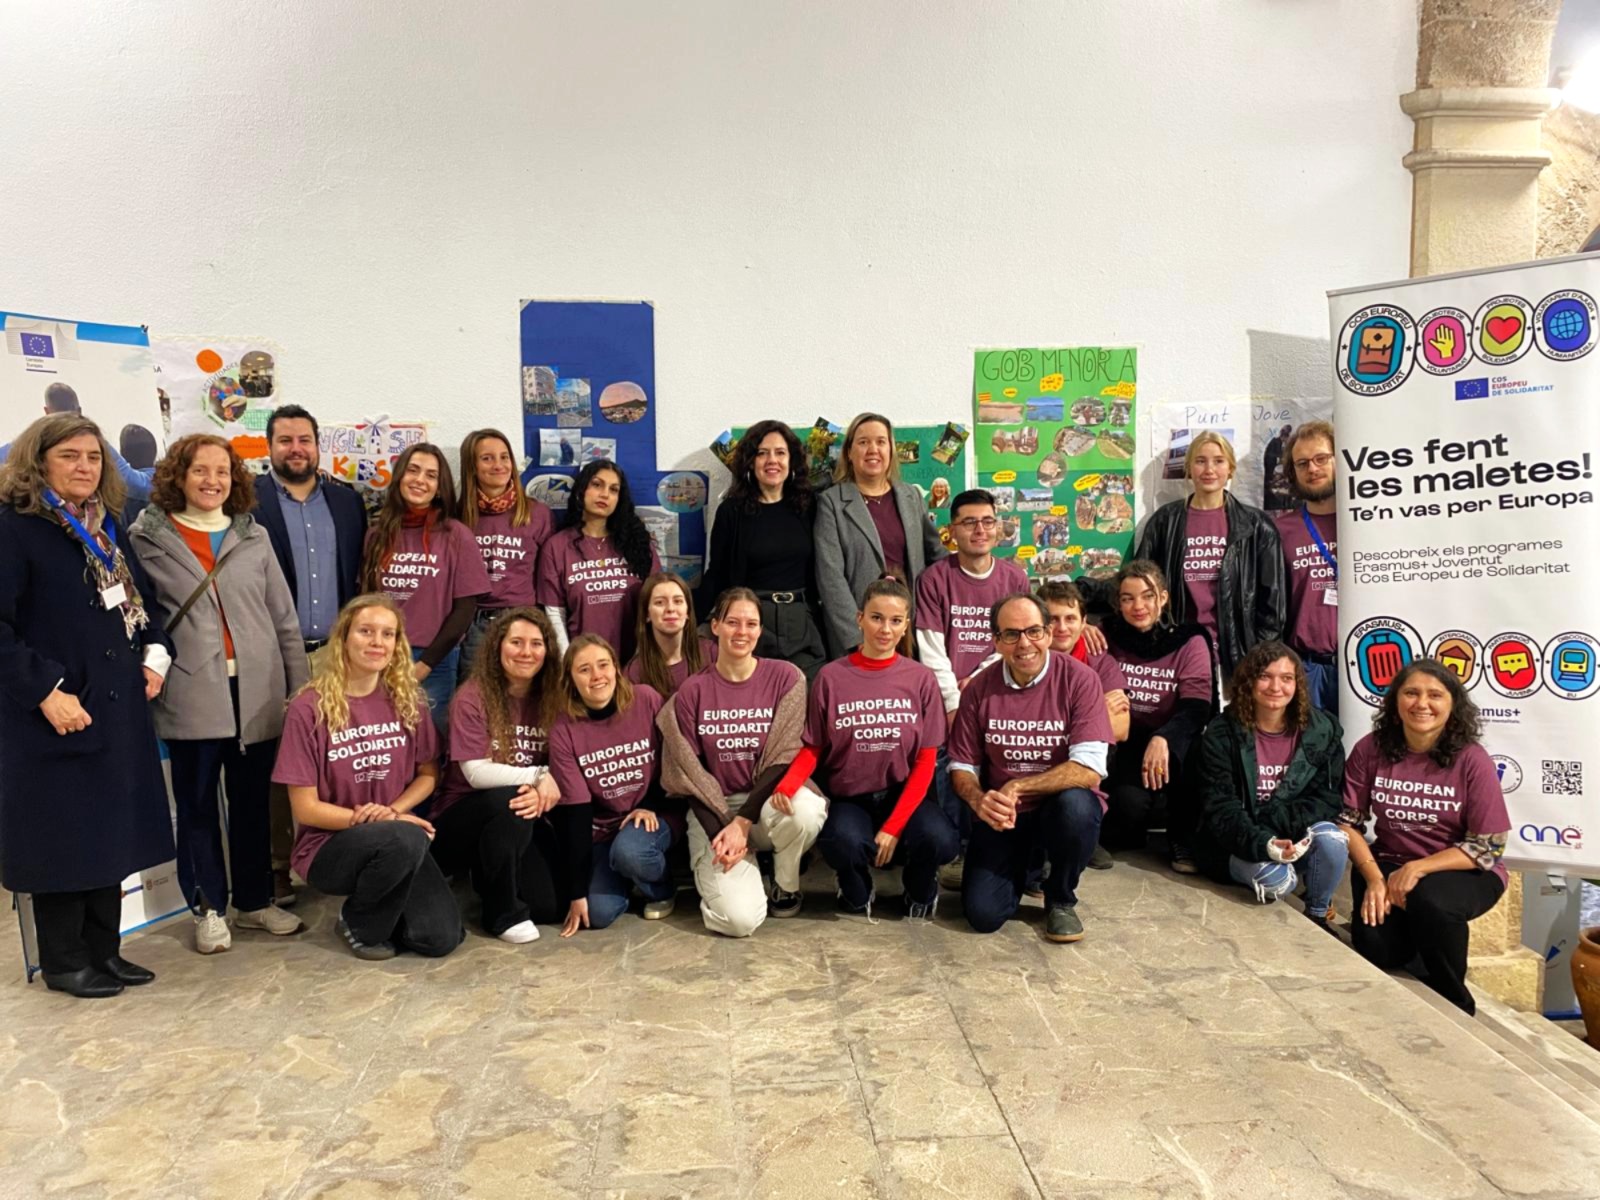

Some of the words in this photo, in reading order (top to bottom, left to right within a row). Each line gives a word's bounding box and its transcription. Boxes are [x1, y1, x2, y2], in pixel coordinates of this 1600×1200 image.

[1486, 297, 1526, 309] PROJECTES
[1349, 312, 1369, 329] COS
[1370, 308, 1413, 330] EUROPEU
[1419, 309, 1455, 329] PROJECTES
[1456, 311, 1465, 321] DE
[982, 349, 1036, 382] GOB
[1426, 357, 1468, 374] VOLUNTARIAT
[1340, 368, 1352, 381] DE
[1349, 370, 1406, 393] SOLIDARITAT
[1491, 380, 1528, 390] EUROPEU
[1504, 385, 1554, 396] SOLIDARITAT
[1185, 406, 1230, 426] Punt
[1253, 405, 1292, 421] Jove
[319, 425, 423, 455] NGLISH
[1342, 446, 1413, 472] Ves
[1423, 433, 1508, 465] fent
[333, 455, 392, 488] KIDS
[1349, 476, 1403, 500] les
[1413, 452, 1593, 494] maletes!
[1349, 505, 1393, 522] Te'n
[1399, 503, 1441, 518] vas
[1448, 497, 1492, 517] per
[1499, 490, 1594, 510] Europa
[475, 534, 522, 547] ROPEAN
[1187, 536, 1227, 546] ROPEA
[1353, 547, 1439, 562] Descobreix
[1442, 545, 1465, 556] els
[1468, 540, 1563, 556] programes
[572, 556, 628, 572] EUROPEA
[1310, 567, 1335, 578] COR
[1353, 560, 1429, 573] Erasmus+
[1432, 555, 1503, 568] Joventut
[568, 568, 629, 584] SOLIDARI
[1354, 573, 1358, 584] i
[1360, 573, 1390, 584] Cos
[1393, 570, 1460, 582] Europeu
[1462, 567, 1483, 578] de
[1486, 562, 1571, 577] Solidaritat
[585, 579, 628, 592] CORPS
[951, 604, 991, 617] EUROPE
[958, 631, 993, 642] CORPS
[1353, 619, 1407, 639] ERASMUS+
[1119, 662, 1175, 679] UROPEAN
[1126, 676, 1178, 692] IDARITY
[1127, 690, 1161, 703] ORPS
[703, 707, 773, 721] EUROPEAN
[837, 698, 911, 715] EUROPEAN
[698, 722, 771, 735] SOLIDARIT
[835, 712, 918, 730] SOLIDARITY
[988, 719, 1064, 731] EUROPEAN
[331, 721, 401, 745] EUROPEAN
[854, 728, 901, 740] CORPS
[985, 732, 1070, 747] SOLIDARITY
[328, 735, 407, 762] SOLIDARITY
[716, 738, 760, 749] CORPS
[578, 738, 651, 767] EUROPEAN
[1003, 750, 1052, 761] CORPS
[583, 750, 656, 779] OLIDARITY
[599, 769, 644, 788] CORPS
[1374, 777, 1455, 797] EUROPEAN
[1370, 790, 1462, 812] SOLIDARITY
[1384, 808, 1438, 824] CORPS
